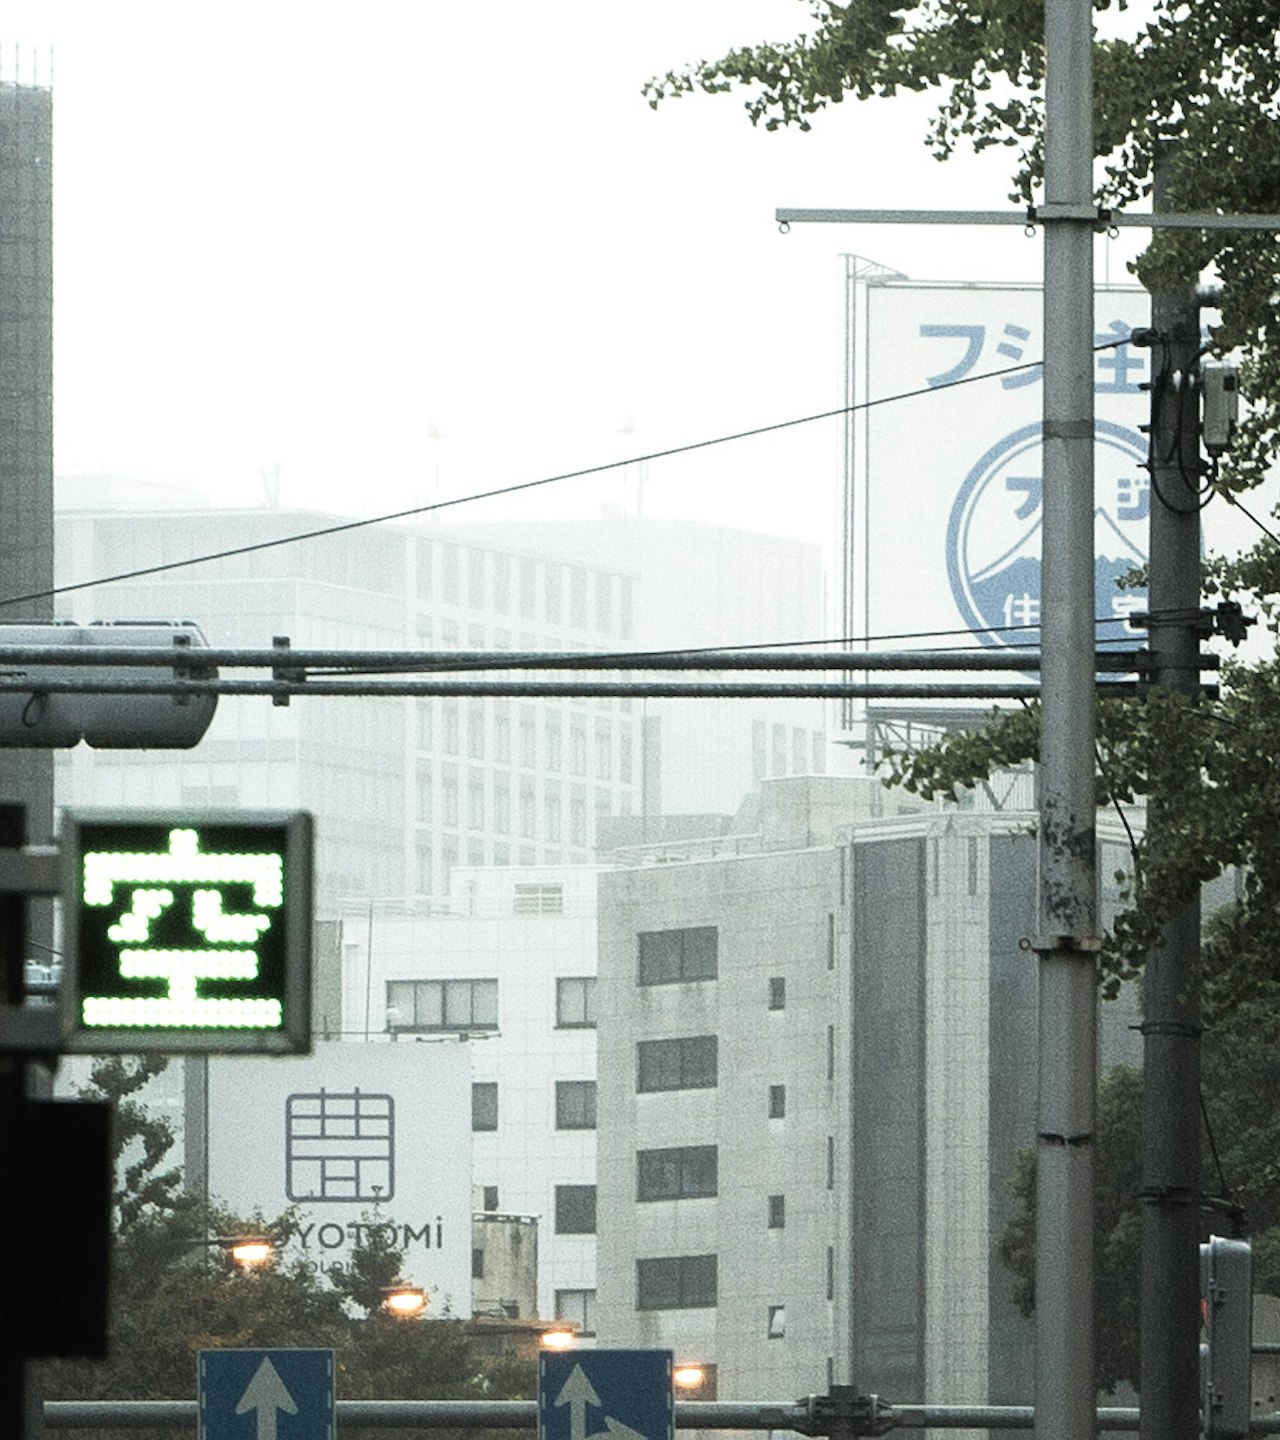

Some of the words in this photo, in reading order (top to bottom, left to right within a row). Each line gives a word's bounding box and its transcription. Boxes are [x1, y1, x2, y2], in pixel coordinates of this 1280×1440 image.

[918, 318, 1153, 394] フジ住
[81, 827, 286, 1030] 空
